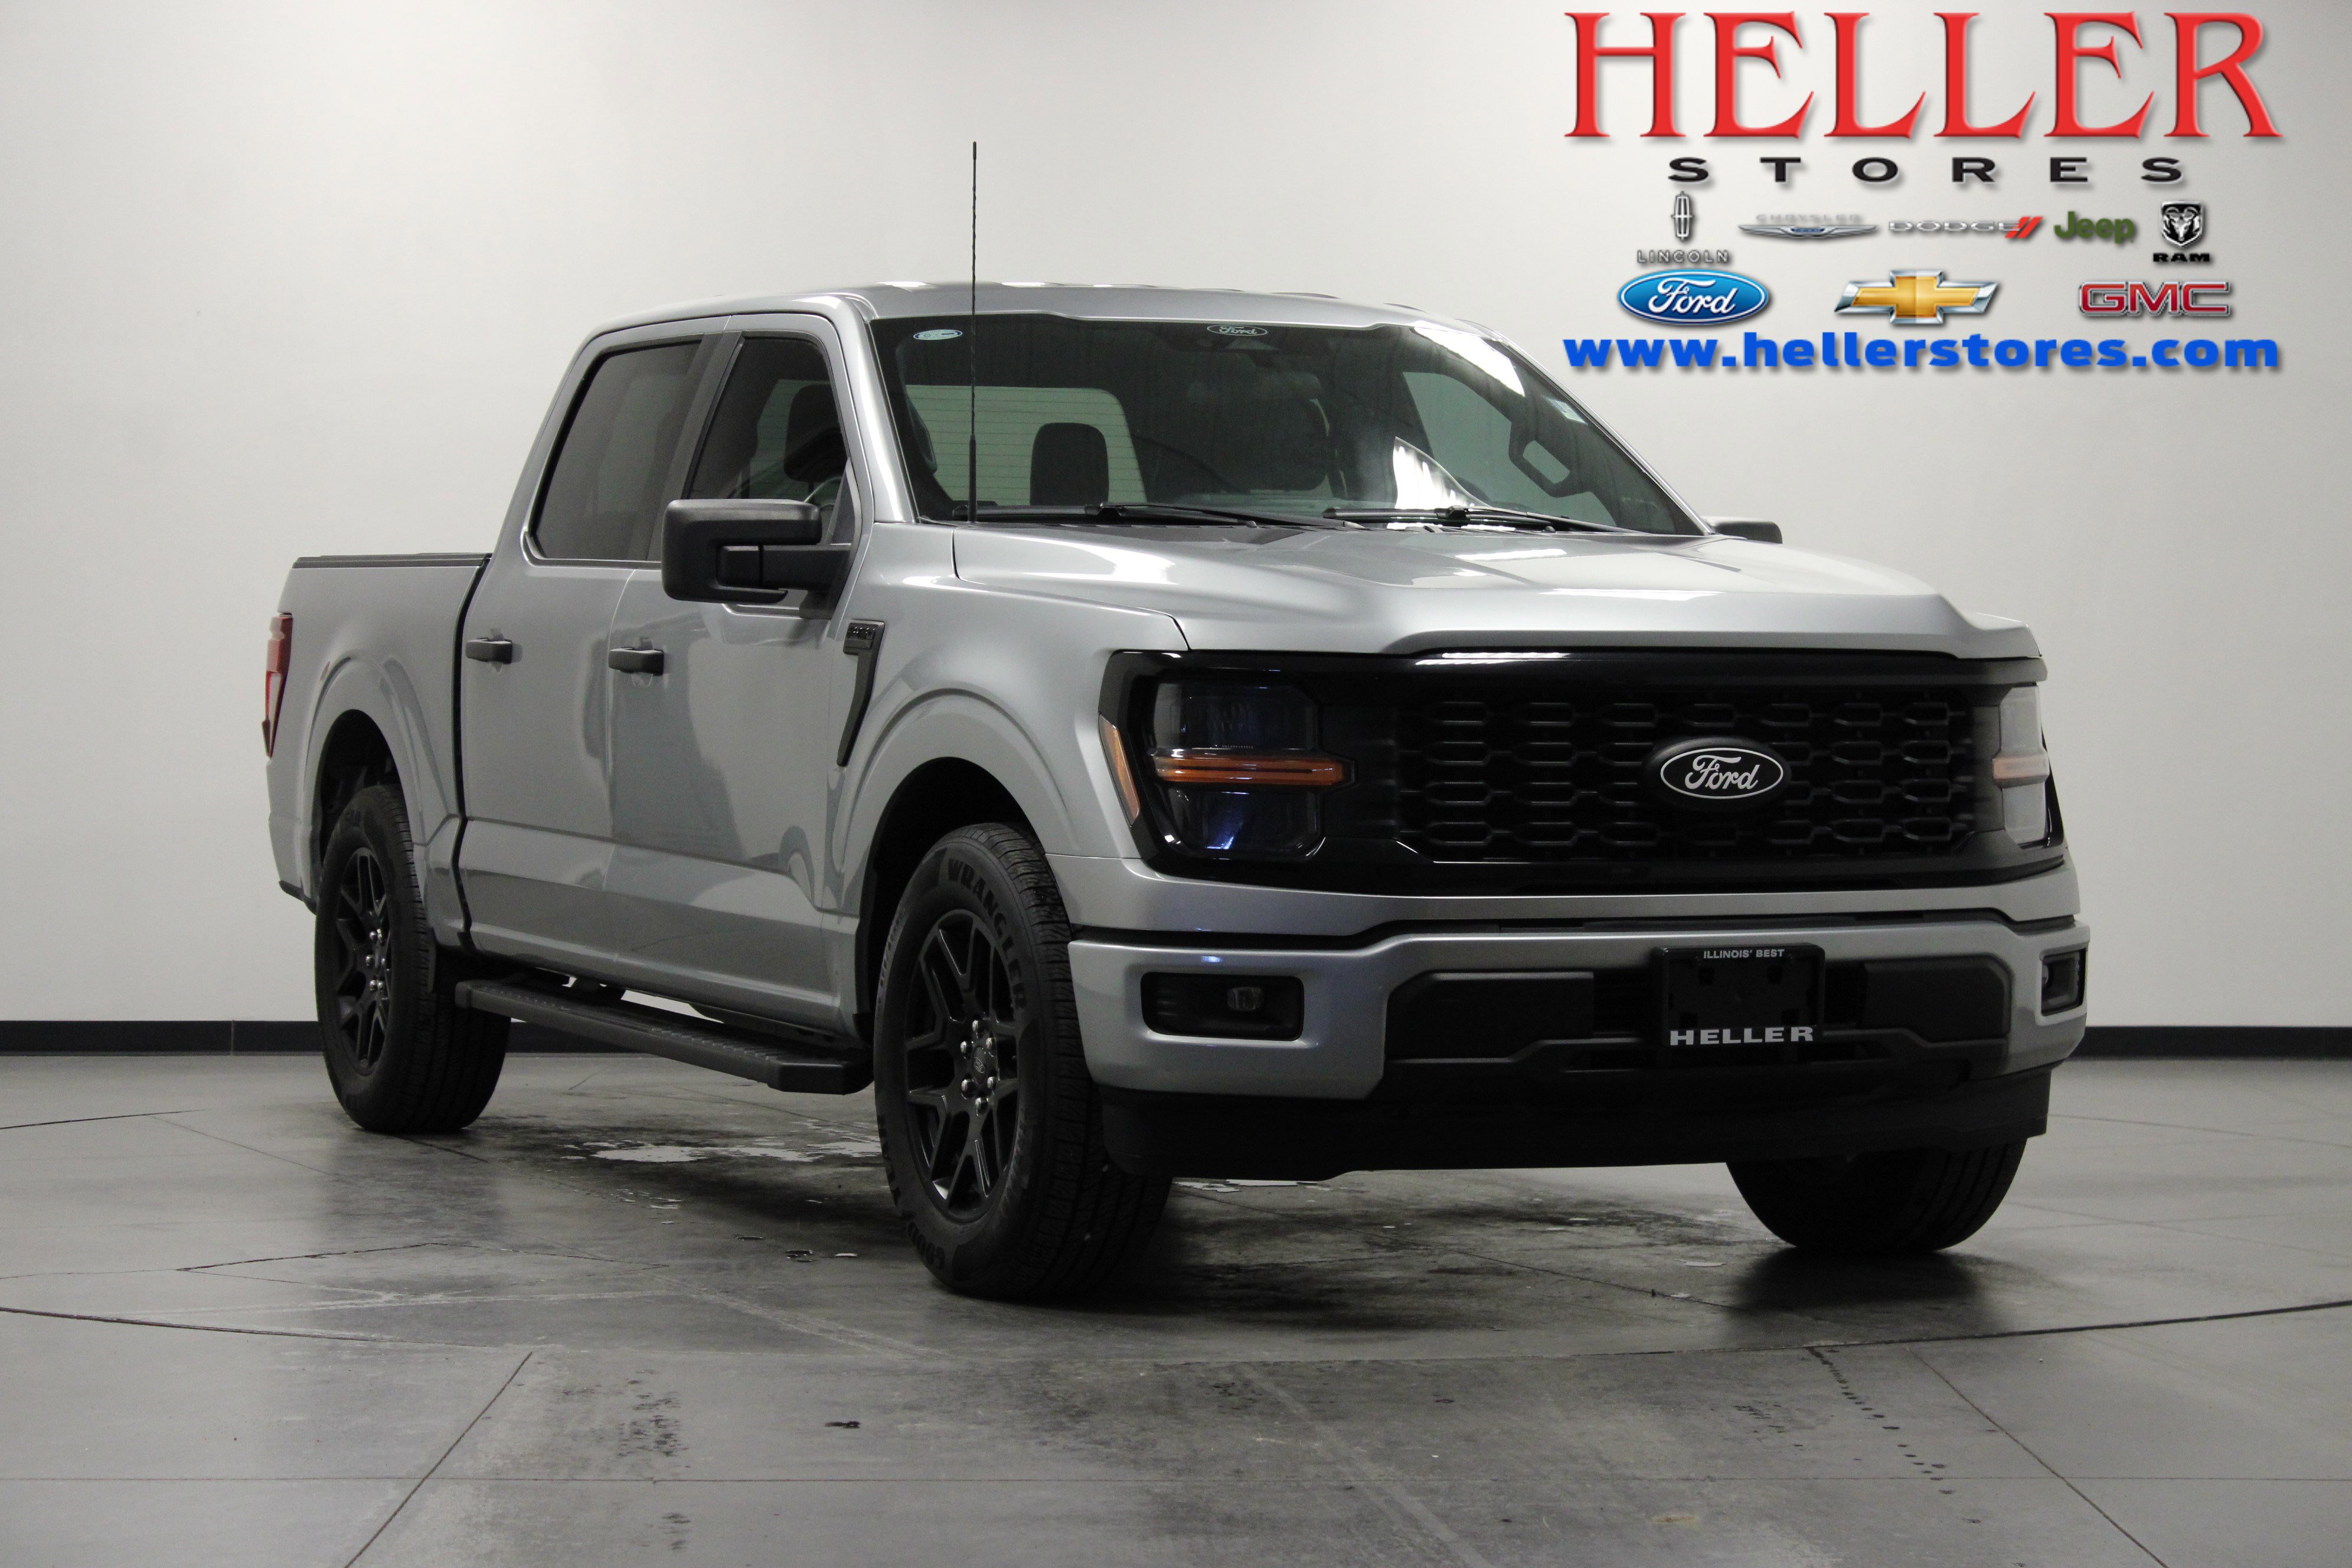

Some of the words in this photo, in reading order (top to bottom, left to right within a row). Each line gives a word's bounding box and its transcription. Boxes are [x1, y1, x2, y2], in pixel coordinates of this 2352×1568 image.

[1219, 325, 1257, 335] Ford
[1685, 754, 1760, 790] Ford
[948, 858, 1027, 1009] WRANGLER
[1704, 949, 1752, 959] ILLINOIS'
[1756, 949, 1785, 958] BEST
[1670, 1027, 1813, 1046] HELLER
